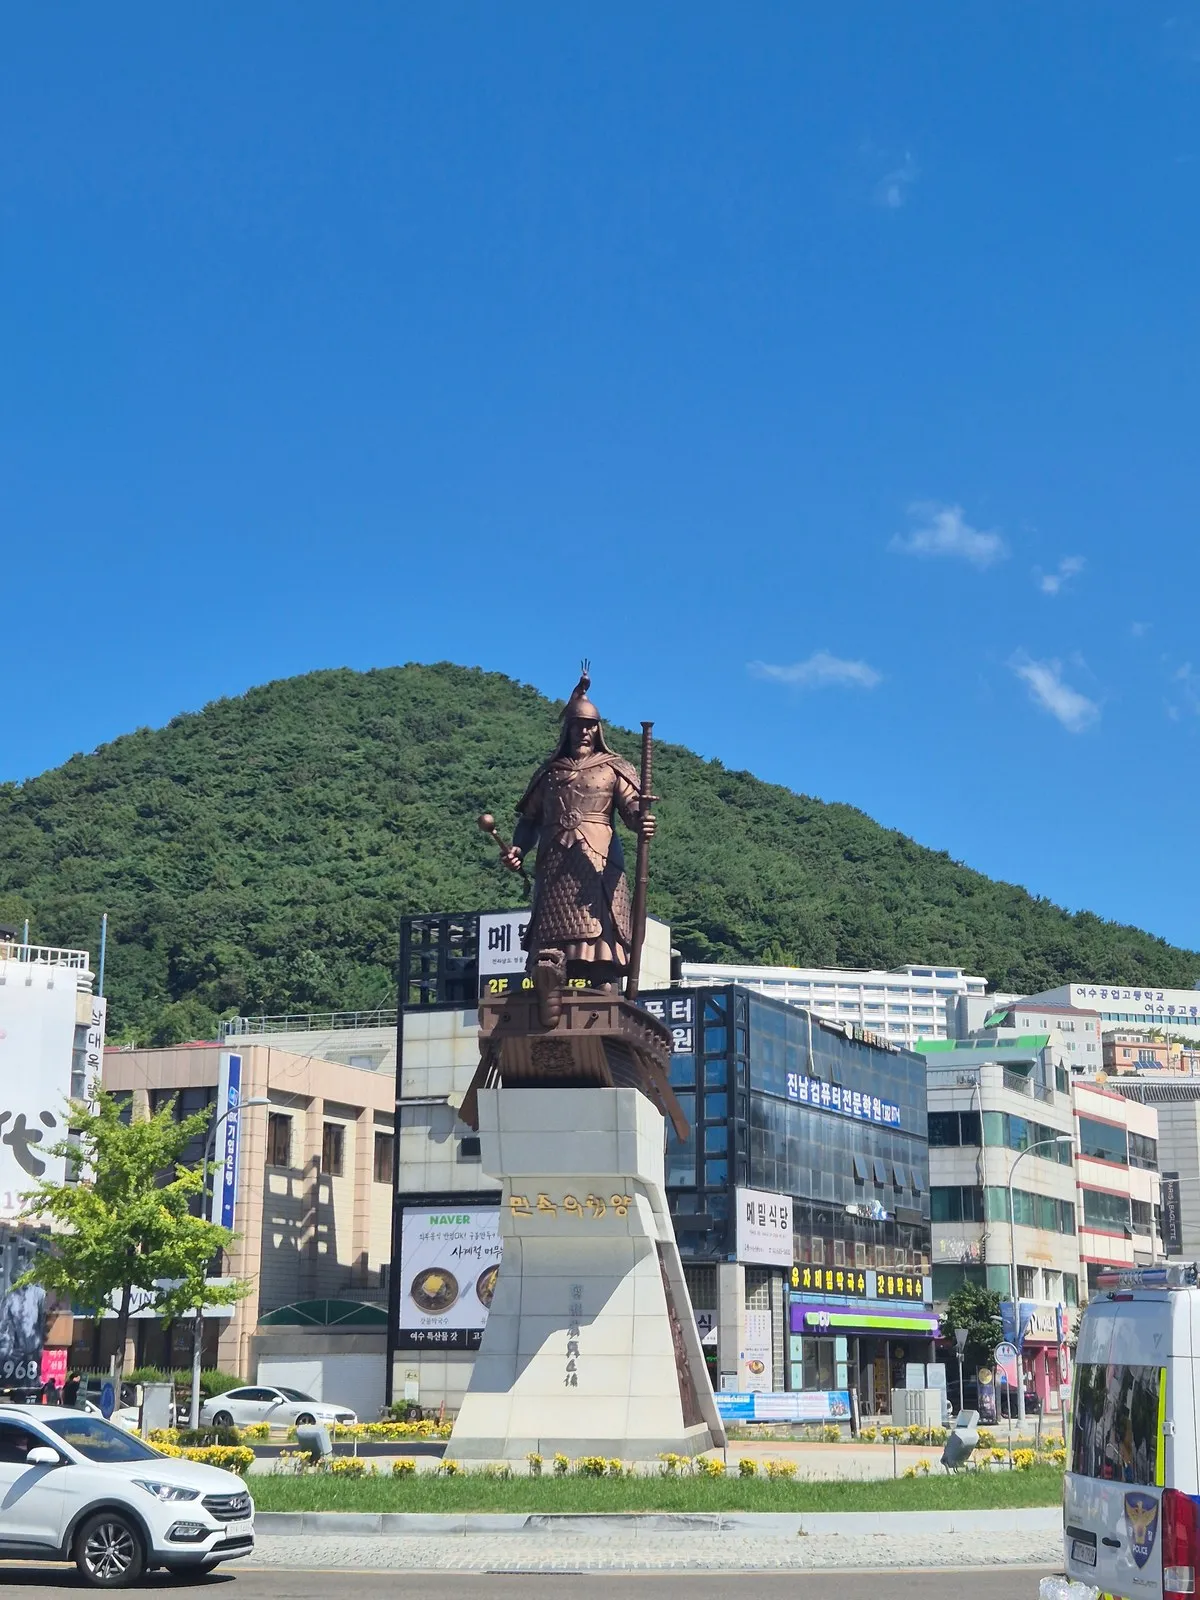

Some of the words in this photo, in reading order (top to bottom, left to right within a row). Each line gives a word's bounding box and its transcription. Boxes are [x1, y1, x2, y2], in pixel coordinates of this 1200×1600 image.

[1076, 987, 1165, 1001] 여수공업고등학교
[429, 1214, 471, 1225] NAVER
[746, 1201, 789, 1230] 메밀식당
[450, 1245, 482, 1259] 사계절
[0, 1360, 39, 1380] 968
[1132, 1543, 1148, 1556] POLICE
